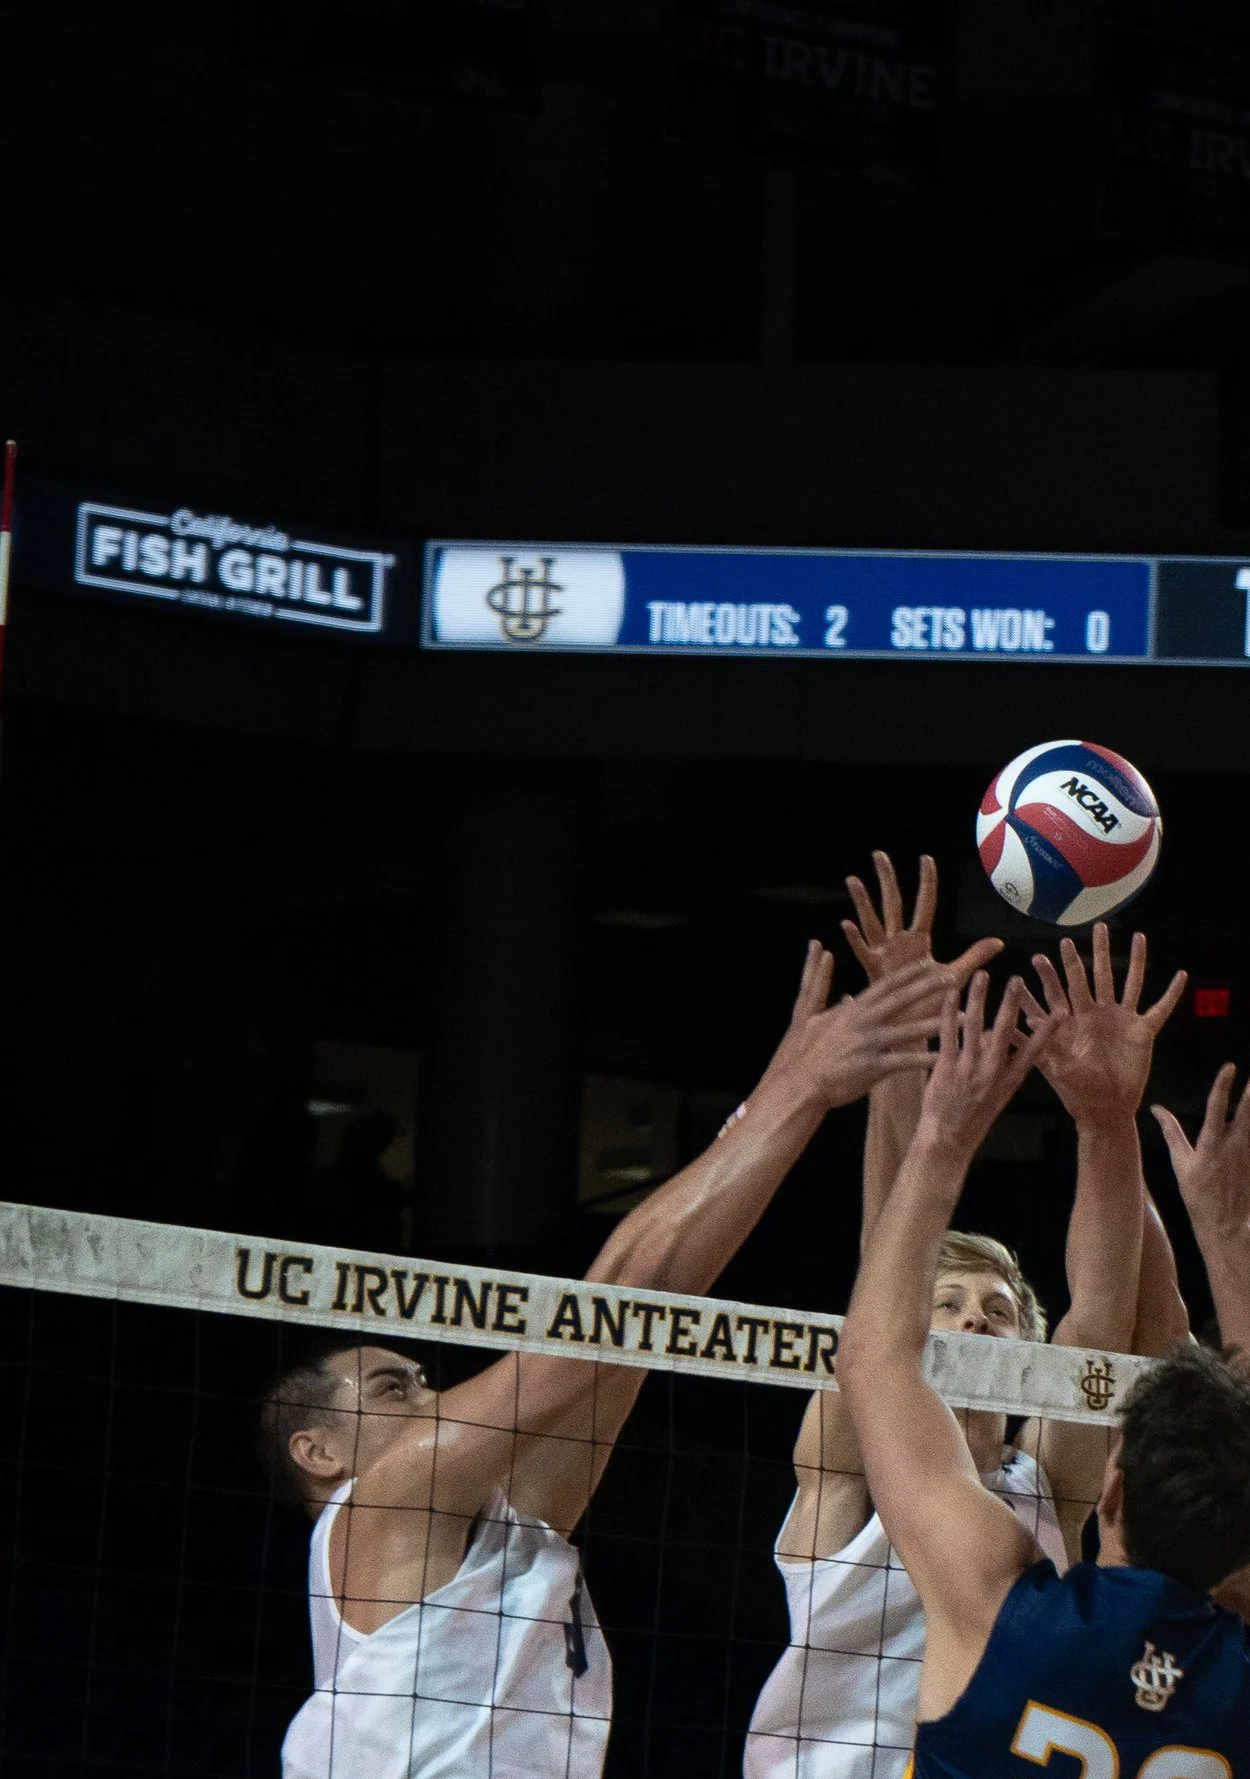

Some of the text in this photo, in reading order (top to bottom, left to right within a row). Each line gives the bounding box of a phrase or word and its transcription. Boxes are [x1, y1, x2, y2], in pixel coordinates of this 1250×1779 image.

[763, 34, 937, 112] IRVINE
[92, 524, 207, 583] FISH
[217, 548, 363, 612] GRILL
[646, 601, 849, 649] TIMEOUTS: 2
[890, 606, 1111, 655] SETS WON: 0
[1059, 776, 1120, 835] NCAA
[235, 1248, 314, 1307] UC
[332, 1261, 530, 1336] IRVINE
